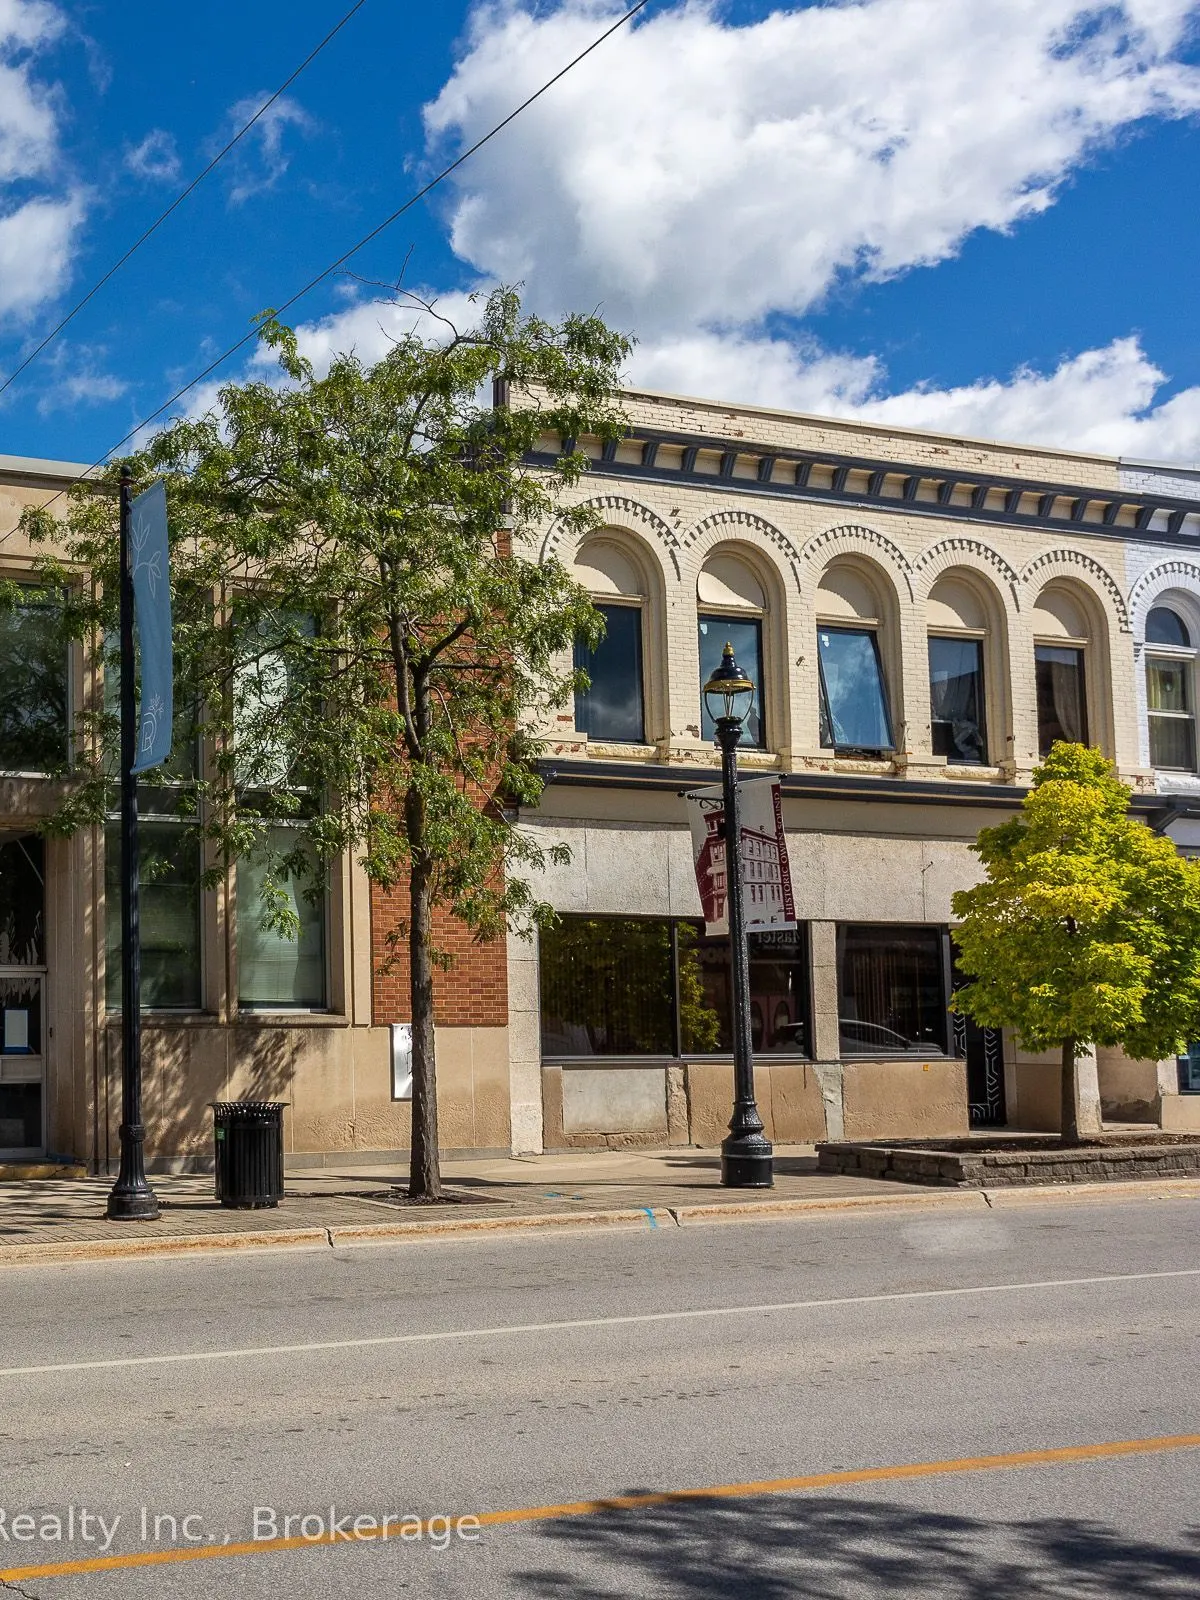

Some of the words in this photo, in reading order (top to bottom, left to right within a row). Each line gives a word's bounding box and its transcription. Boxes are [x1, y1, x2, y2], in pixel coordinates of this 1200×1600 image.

[774, 792, 783, 832] SOUND
[777, 832, 788, 864] OWEN
[781, 866, 794, 916] HISTORIC
